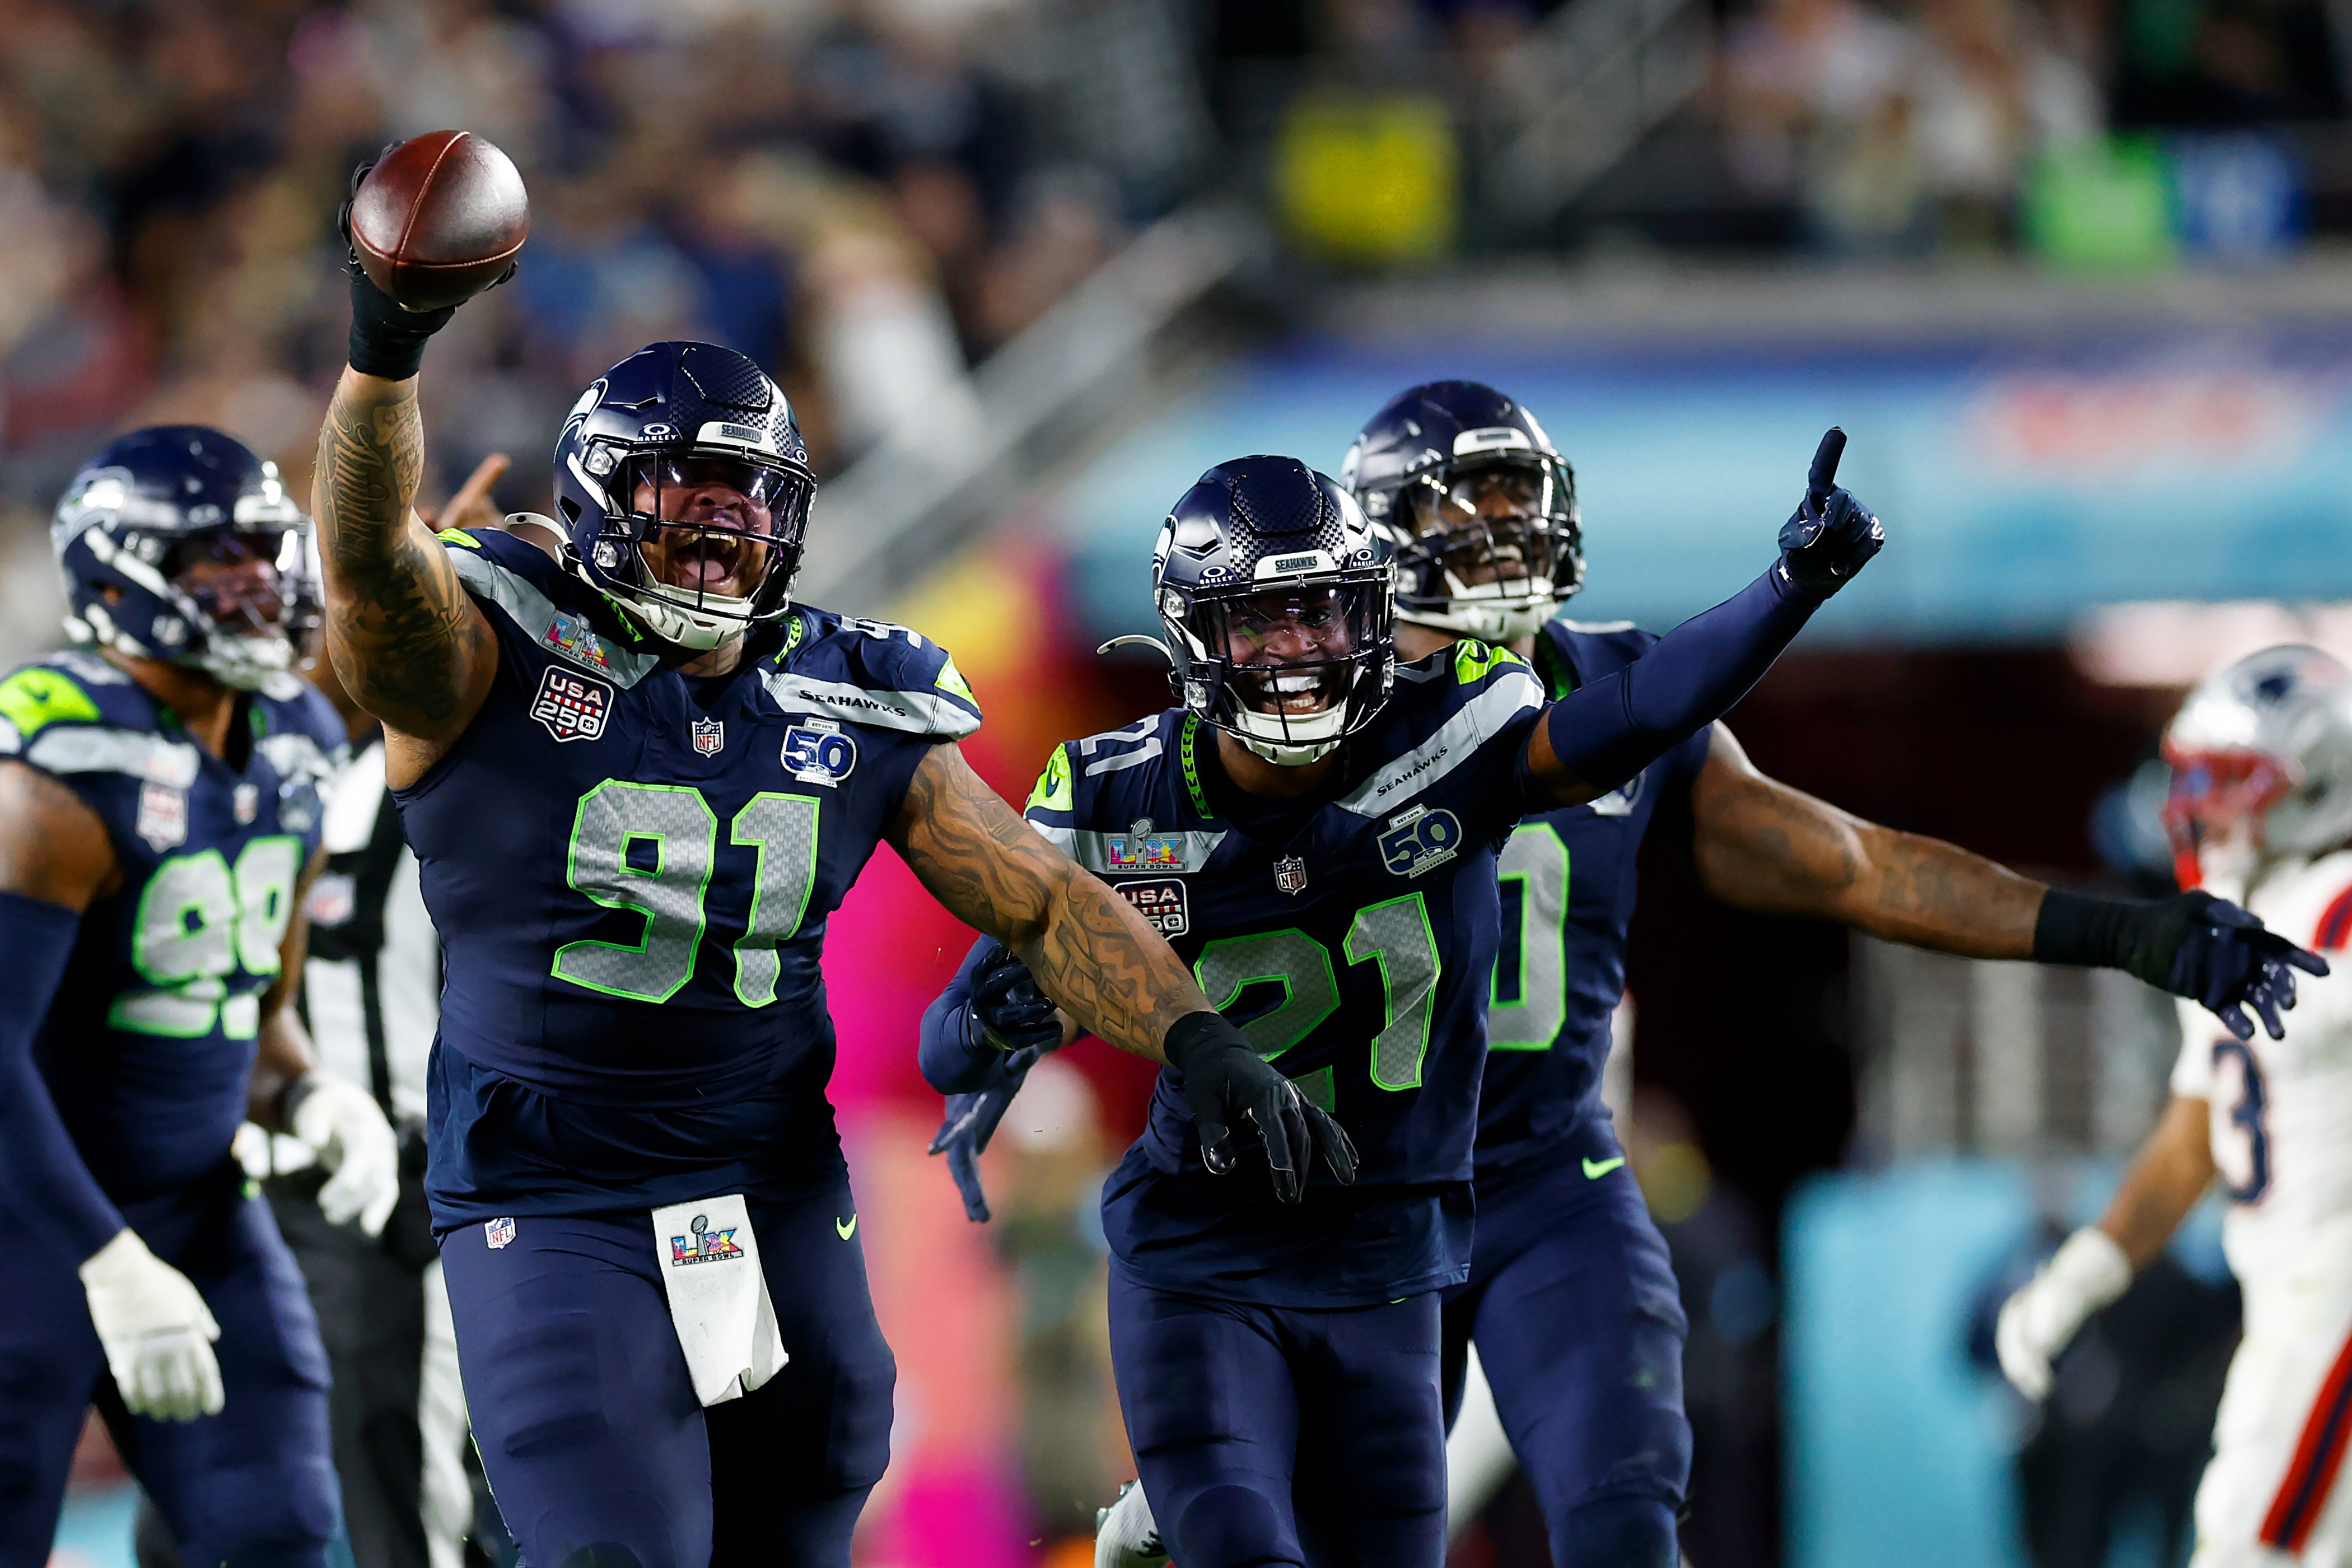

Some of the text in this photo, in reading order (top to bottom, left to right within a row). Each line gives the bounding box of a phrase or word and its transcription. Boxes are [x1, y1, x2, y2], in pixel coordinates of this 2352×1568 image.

[721, 424, 762, 443] SEAHAWKS
[1275, 556, 1318, 573] SEAHAWKS
[1200, 575, 1233, 585] OAKLEY
[553, 643, 603, 670] SUPER BOWL
[549, 674, 603, 706] USA
[799, 690, 906, 716] SEAHAWKS
[535, 700, 600, 735] 250
[698, 735, 718, 750] NFL
[784, 729, 855, 777] 50
[1080, 715, 1163, 777] 21
[1376, 746, 1448, 796] SEAHAWKS
[1380, 811, 1459, 872] 50
[551, 778, 820, 1008] 91
[1280, 872, 1302, 888] NFL
[1120, 886, 1179, 905] USA
[1145, 914, 1184, 932] 50
[1193, 892, 1441, 1113] 21
[492, 1228, 511, 1243] NFL
